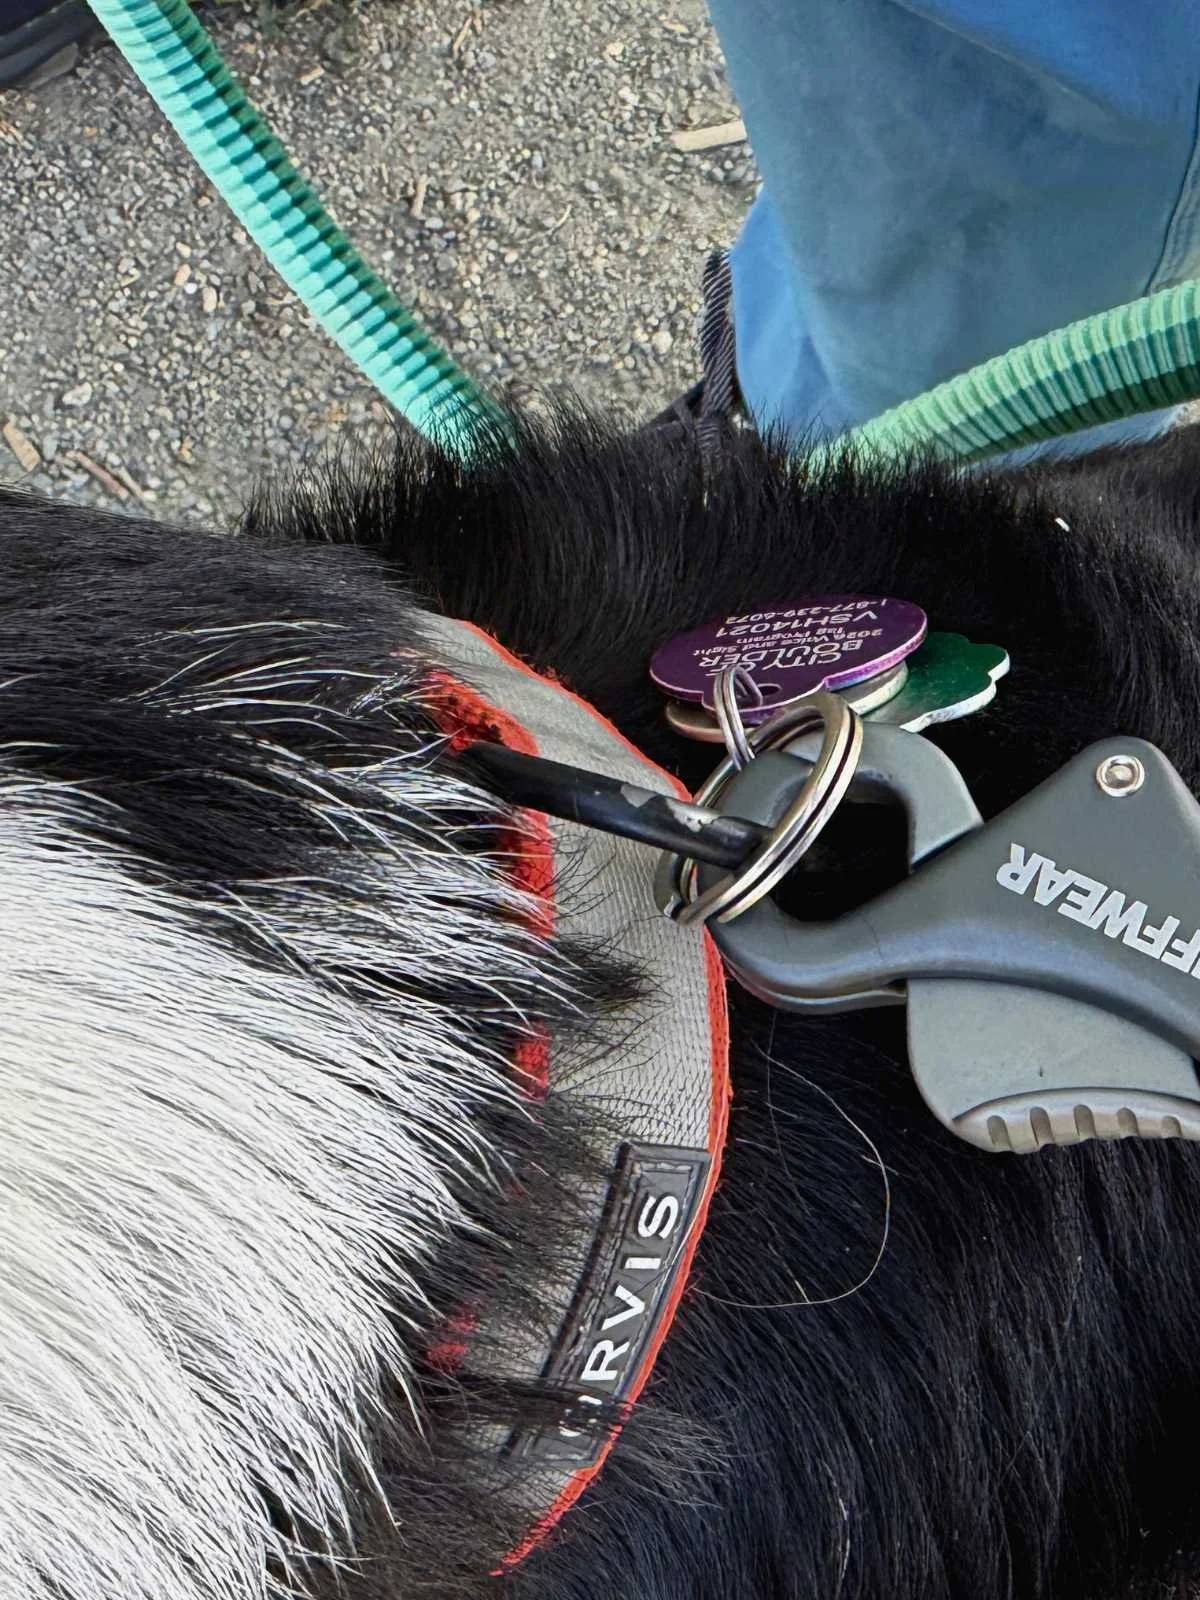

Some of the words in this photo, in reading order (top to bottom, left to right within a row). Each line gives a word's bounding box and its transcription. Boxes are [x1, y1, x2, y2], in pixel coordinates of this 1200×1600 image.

[716, 610, 878, 638] VSH14021
[699, 639, 864, 667] BOULDER
[742, 640, 777, 651] and
[762, 652, 842, 671] CITY
